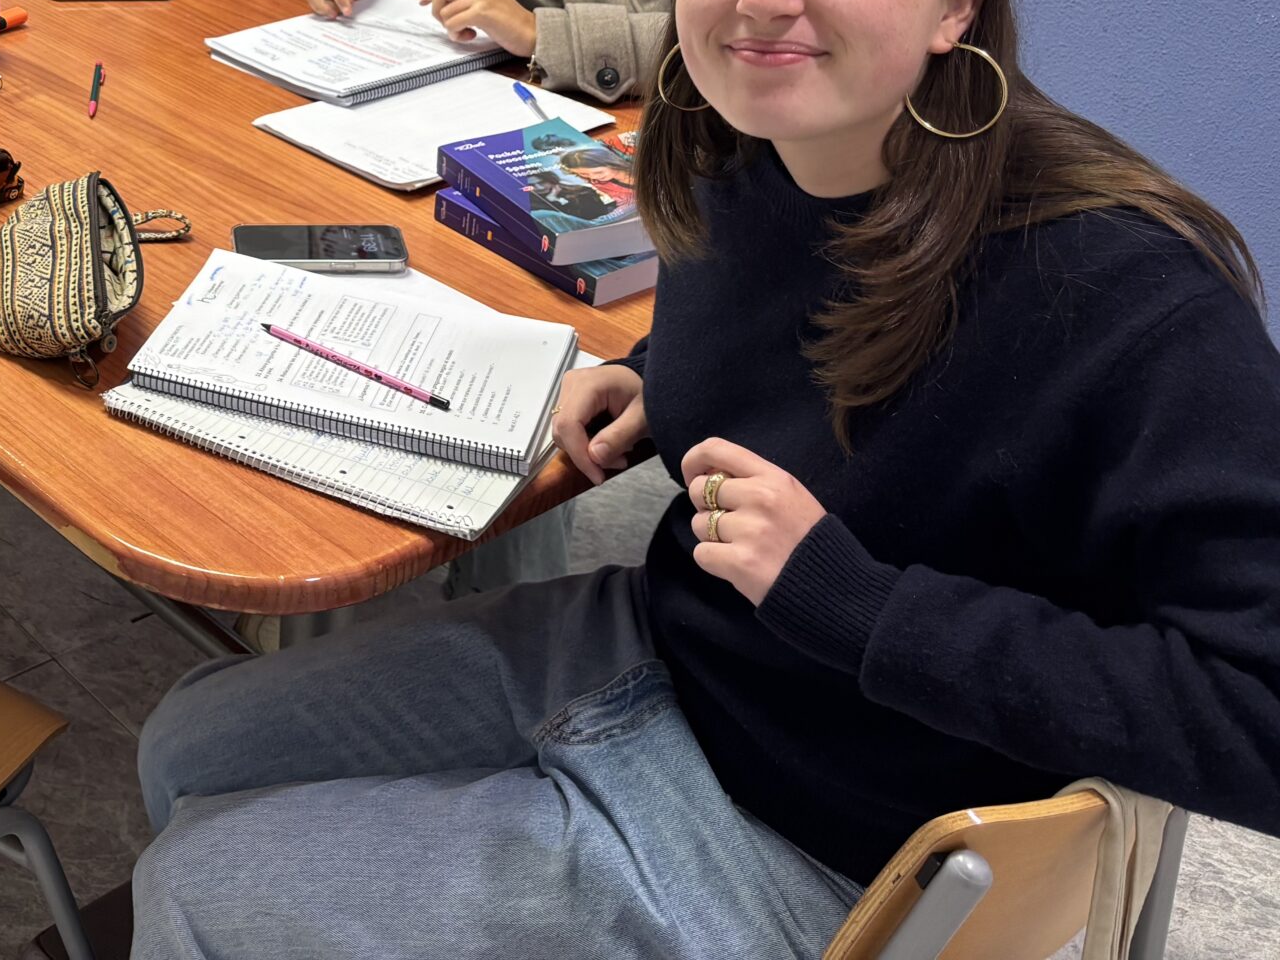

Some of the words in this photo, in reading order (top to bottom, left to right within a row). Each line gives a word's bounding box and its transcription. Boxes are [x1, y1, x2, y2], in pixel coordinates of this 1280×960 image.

[488, 150, 526, 160] Pocket-
[495, 146, 566, 166] woordenboek
[505, 161, 543, 173] Spaans
